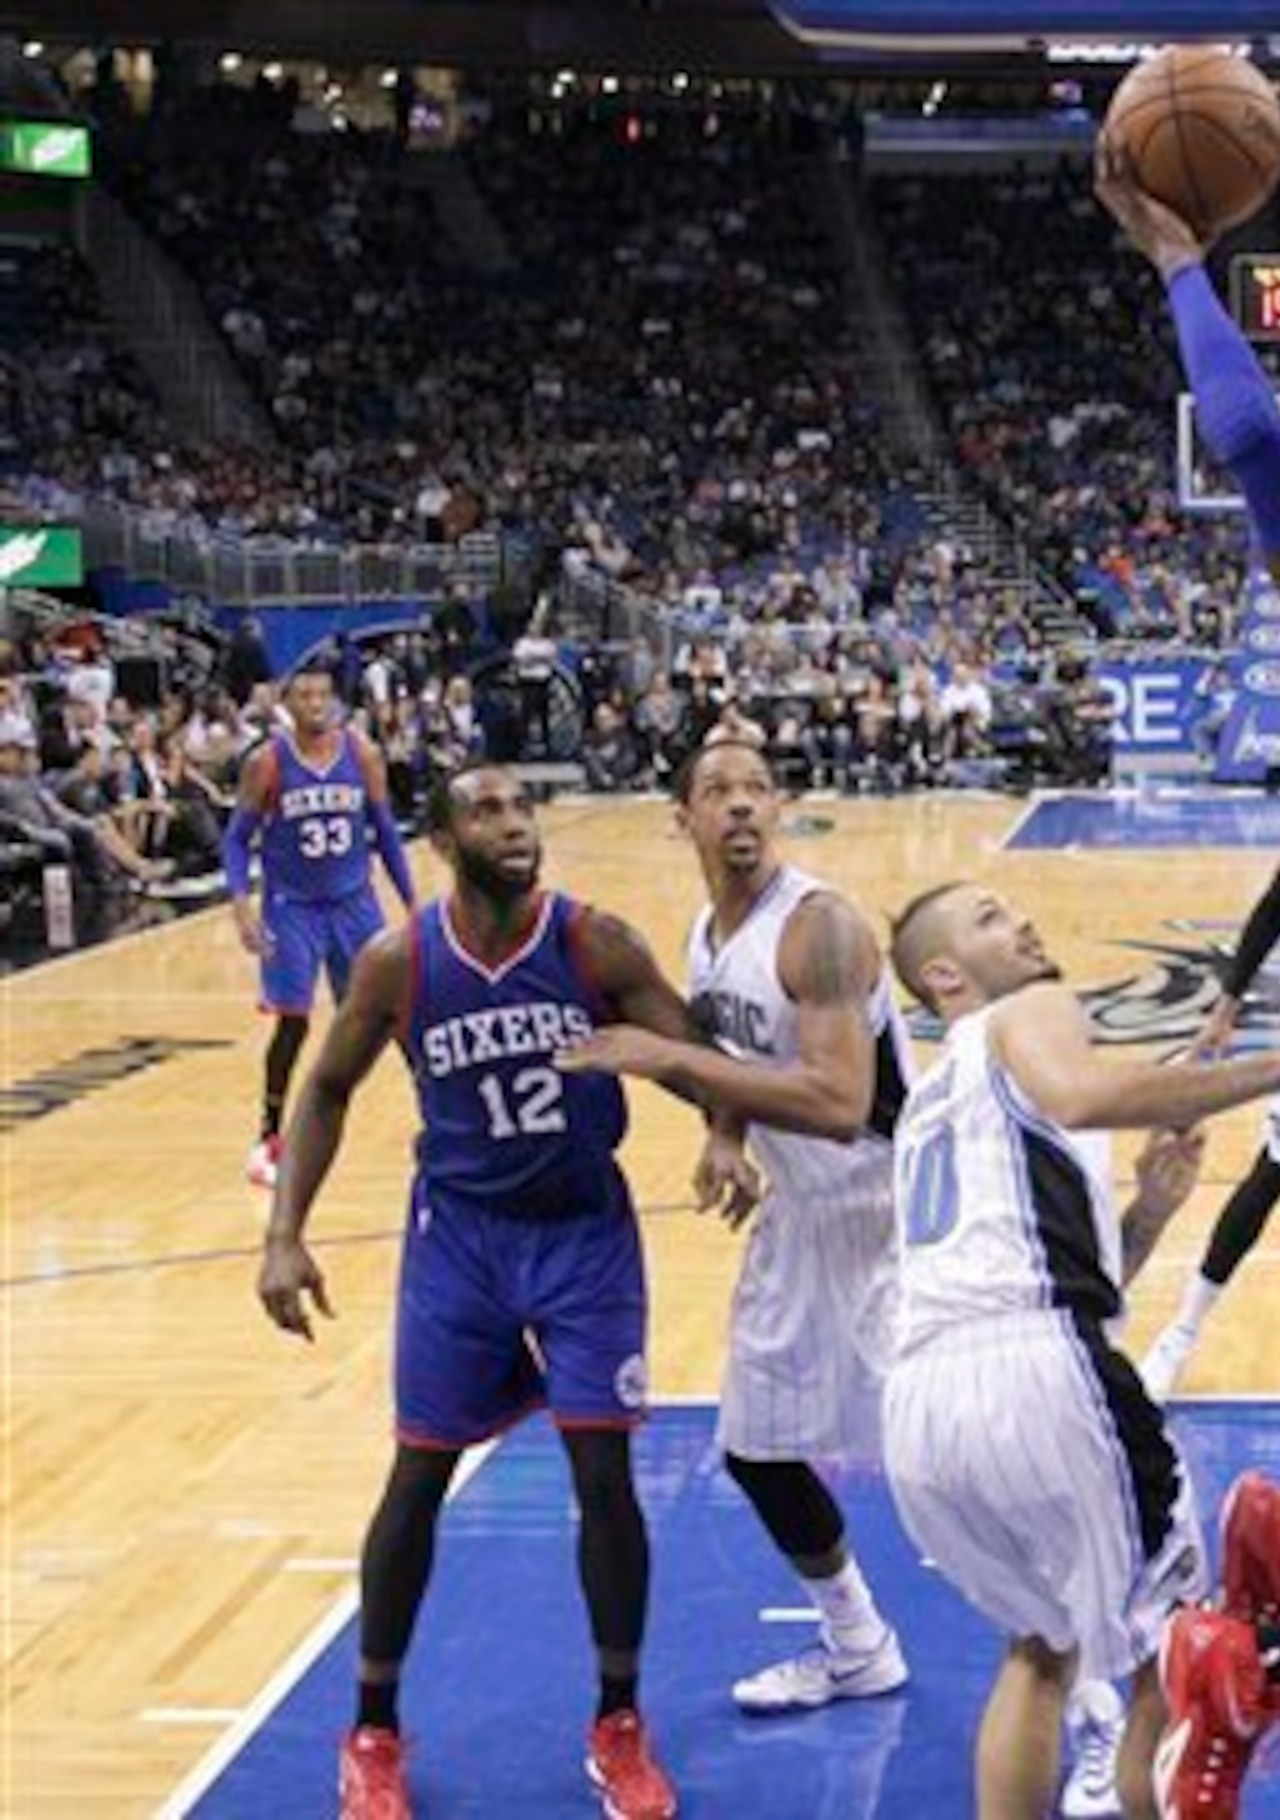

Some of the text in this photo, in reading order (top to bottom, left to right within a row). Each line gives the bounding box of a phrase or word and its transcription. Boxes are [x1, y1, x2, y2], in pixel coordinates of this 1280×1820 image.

[281, 783, 364, 819] SIXERS
[300, 817, 352, 858] 33
[423, 1002, 594, 1078] SIXERS
[478, 1065, 568, 1138] 12
